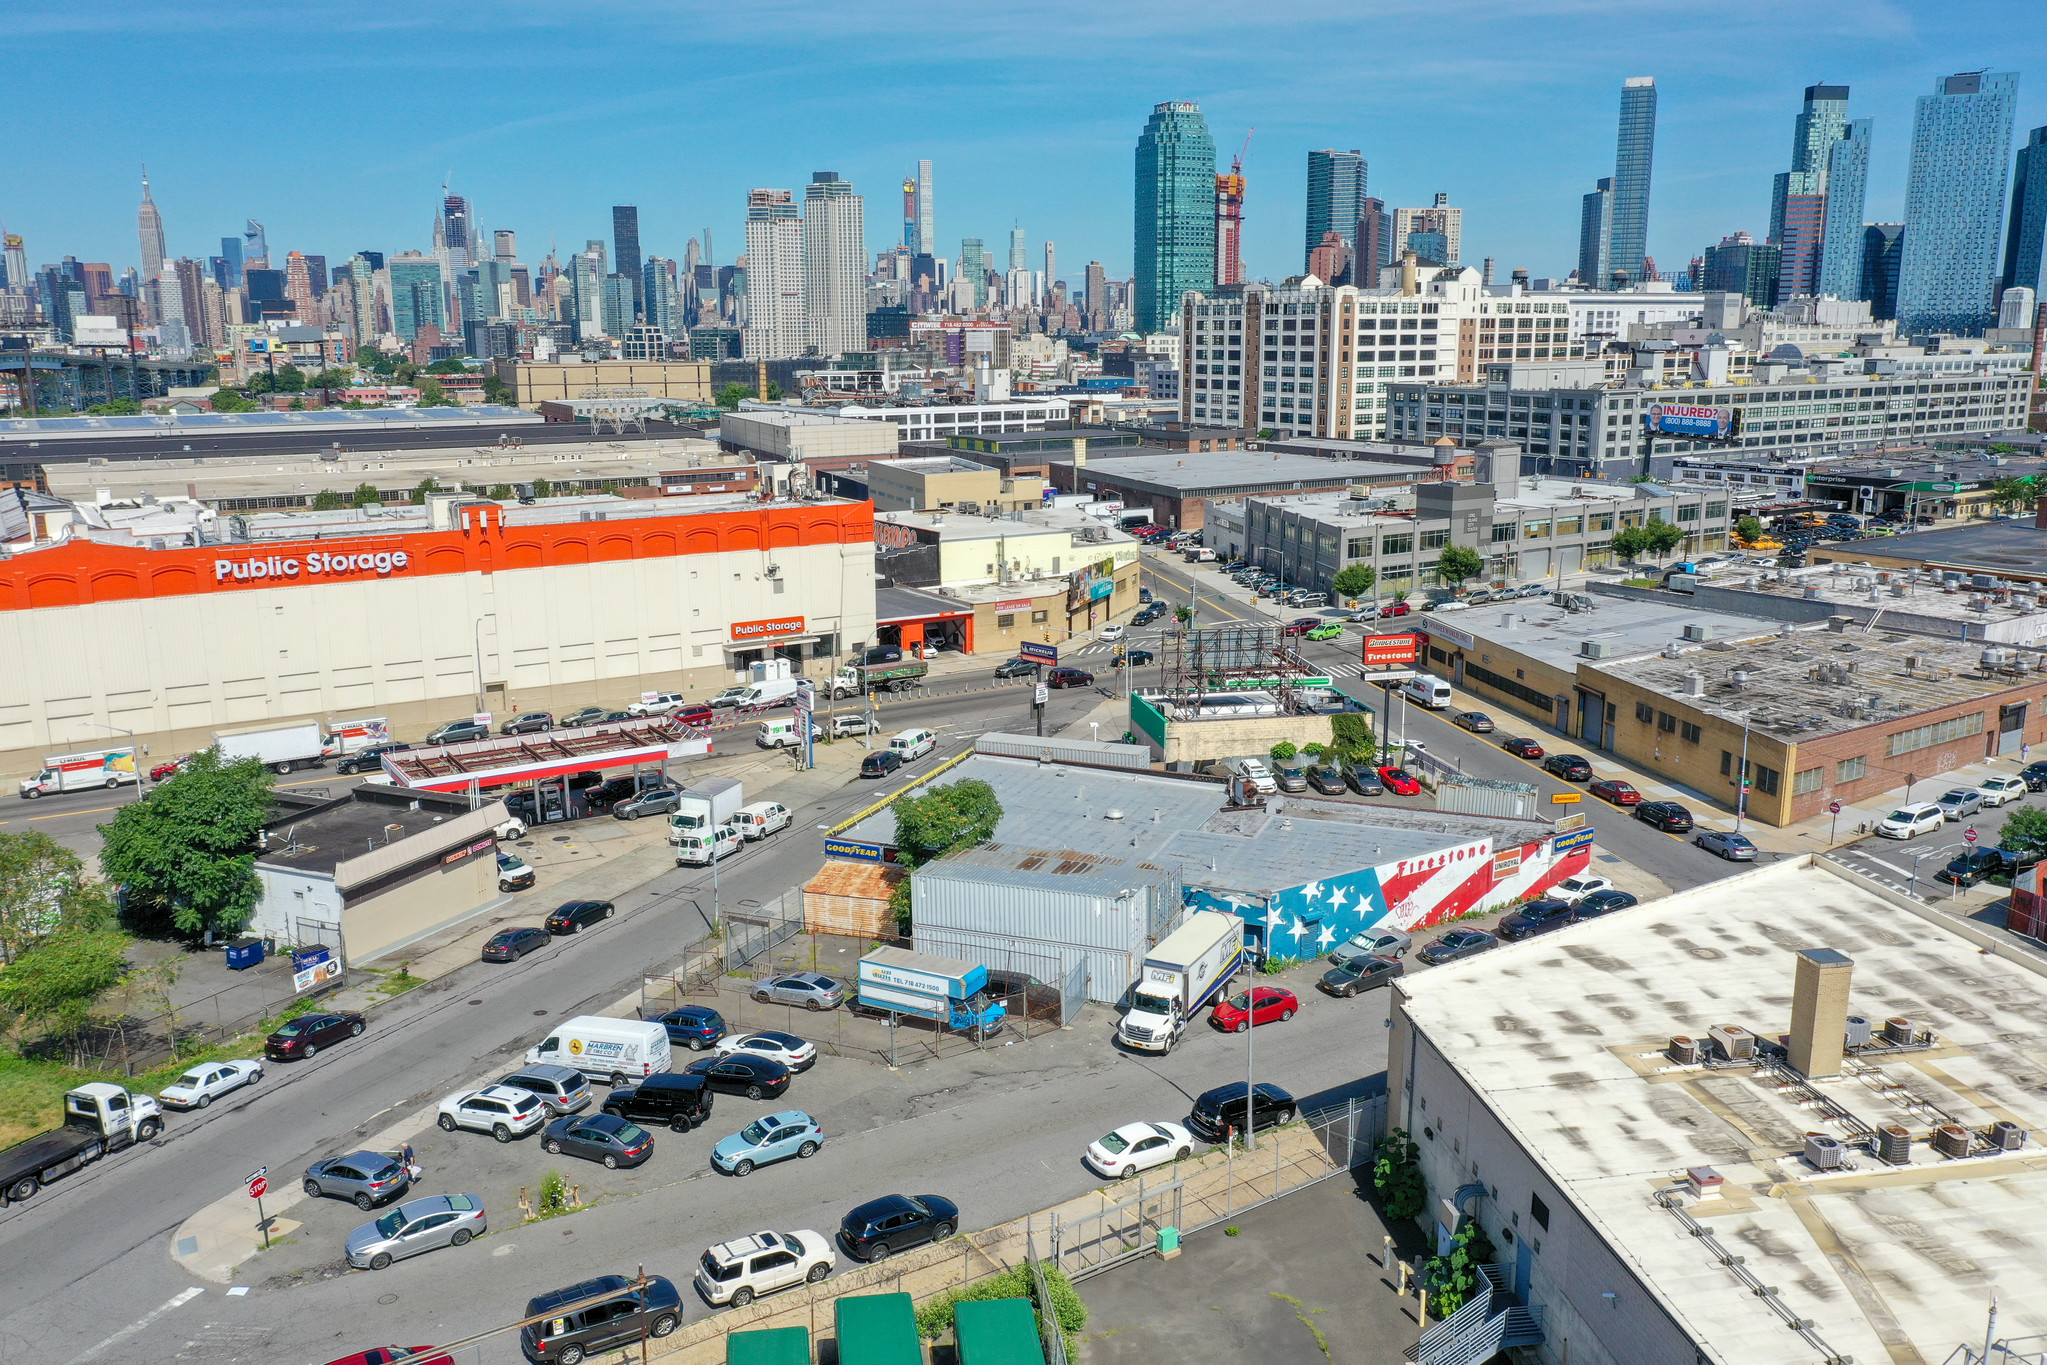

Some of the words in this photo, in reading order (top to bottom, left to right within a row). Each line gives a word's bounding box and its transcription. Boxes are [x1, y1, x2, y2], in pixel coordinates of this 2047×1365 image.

[1664, 406, 1718, 418] INJURED?
[1682, 418, 1712, 427] 888-8888
[1809, 475, 1846, 483] enterprise
[215, 556, 300, 580] Public
[306, 551, 408, 574] Storage
[736, 625, 764, 635] Public
[766, 622, 802, 631] Storage
[1029, 647, 1054, 656] MICHELIN
[1368, 652, 1412, 662] Firestone
[1556, 833, 1593, 848] GOODYEAR
[826, 844, 878, 857] GOODYEAR
[1396, 844, 1486, 879] Firestone
[1495, 858, 1519, 870] UNIROYAL
[587, 1041, 624, 1051] MARBREN
[250, 1180, 266, 1196] STOP
